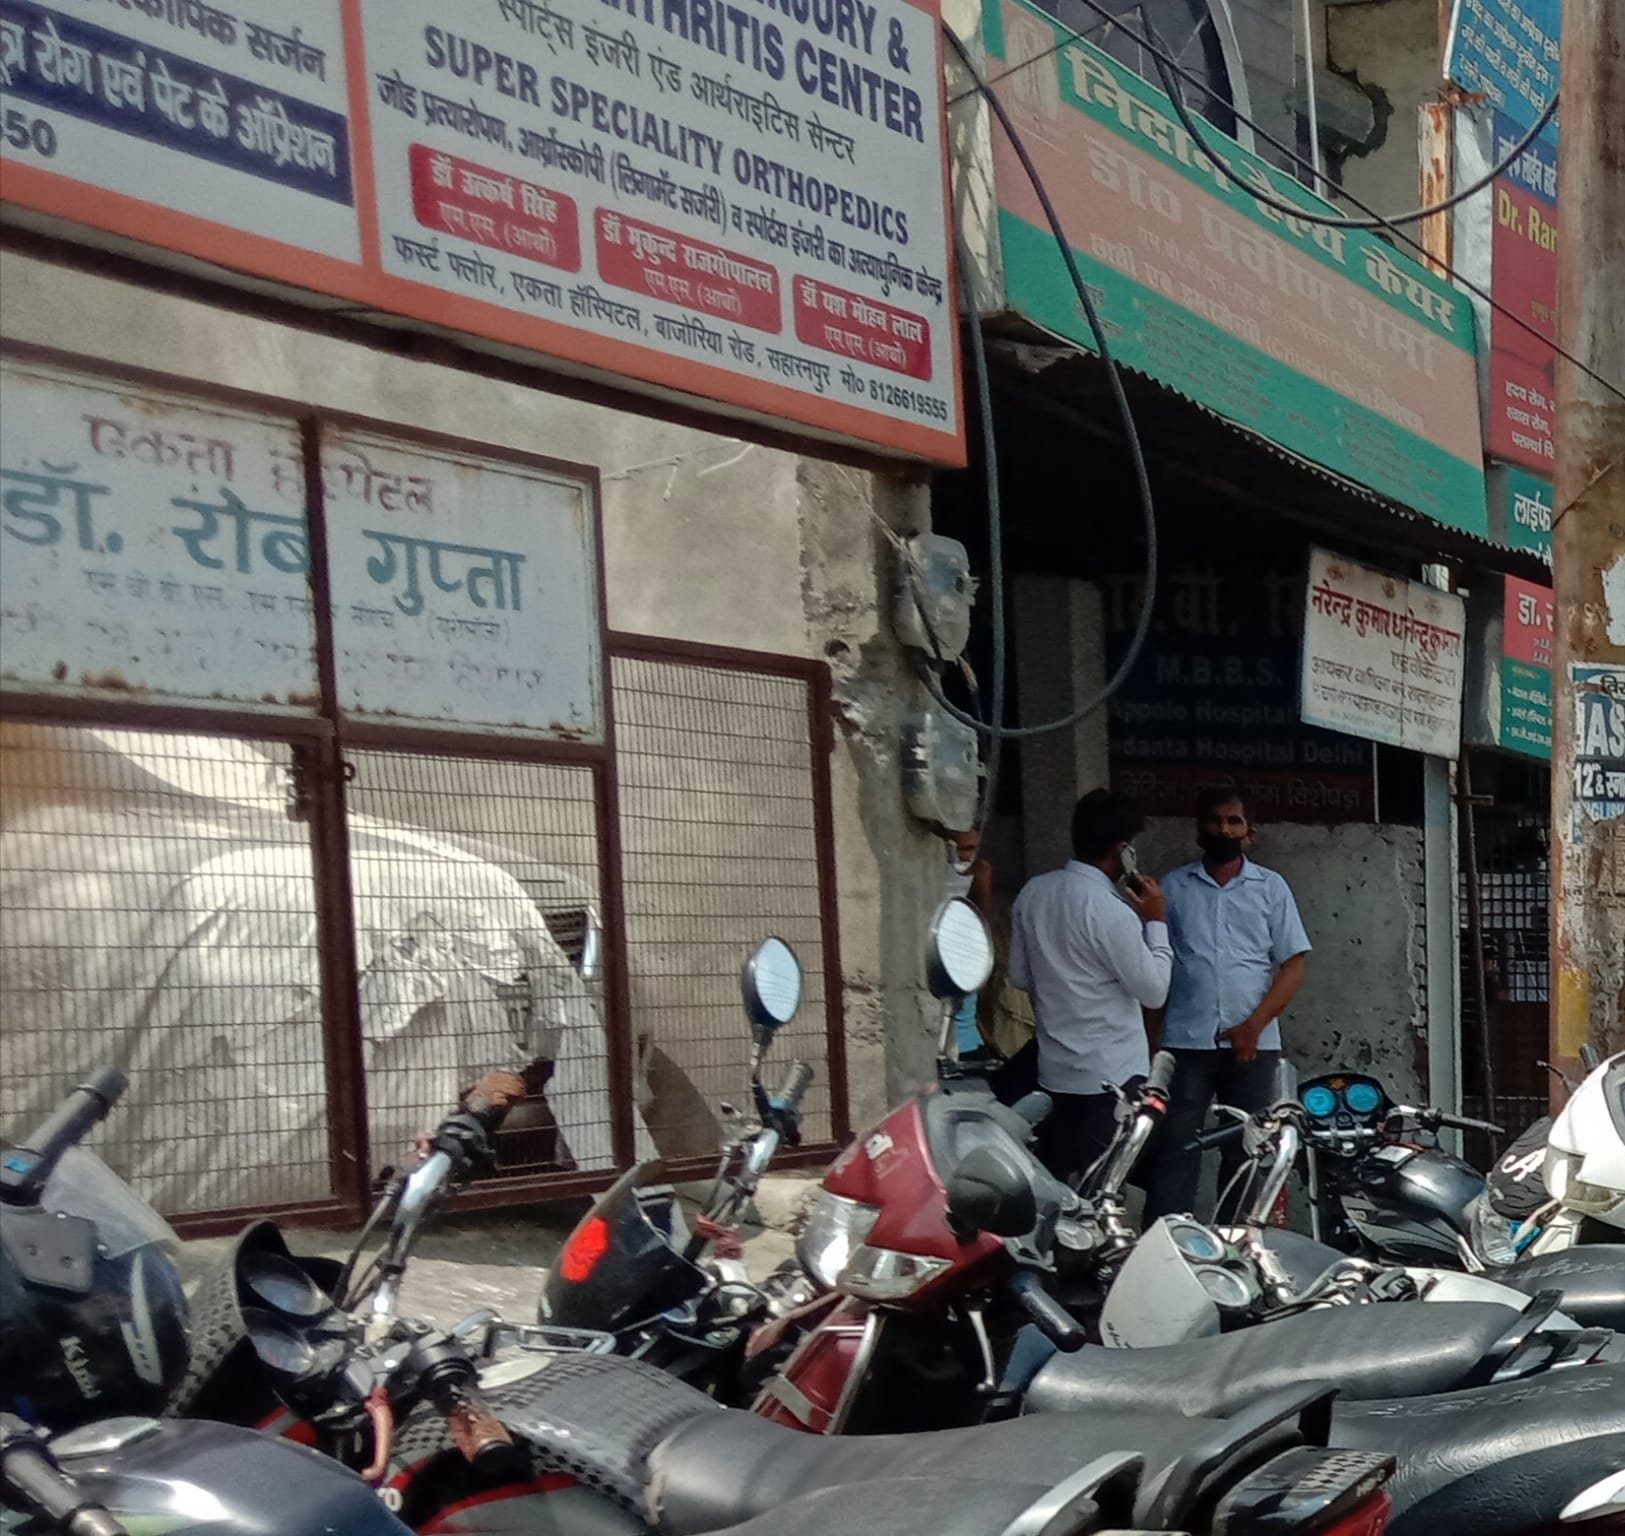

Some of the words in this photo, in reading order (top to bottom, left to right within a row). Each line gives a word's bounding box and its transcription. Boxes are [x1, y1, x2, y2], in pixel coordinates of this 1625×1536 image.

[33, 16, 93, 94] रोग
[98, 50, 146, 112] एवं
[150, 57, 196, 129] पेट
[196, 78, 229, 137] के
[245, 20, 326, 82] सर्जन
[888, 17, 910, 74] &
[581, 19, 640, 77] इंजरी
[690, 70, 801, 142] आर्थराइटिस
[805, 111, 856, 165] सेन्टर
[795, 38, 925, 143] CENTER
[0, 108, 57, 158] 50
[424, 24, 541, 107] SUPER
[550, 75, 724, 176] SPECIALITY
[732, 146, 909, 246] ORTHOPEDICS
[731, 203, 743, 232] व
[827, 240, 847, 270] का
[1499, 188, 1523, 237] Dr.
[682, 242, 773, 295] राजगोपालन
[1360, 244, 1456, 333] केयर
[392, 234, 440, 273] फर्स्ट
[510, 270, 562, 310] एकता
[653, 310, 723, 355] बाजोरिया
[766, 346, 832, 394] सहारनपुर
[850, 297, 887, 333] मोहन
[889, 312, 923, 345] लाल
[1346, 288, 1438, 386] शर्मा
[82, 412, 235, 483] एकता
[0, 460, 123, 555] डॉ.
[362, 528, 527, 617] गुप्ता
[1312, 578, 1354, 628] नरेन्द्र
[1354, 598, 1391, 638] कुमार
[1195, 735, 1296, 767] Hospital
[1303, 738, 1366, 768] Delhi
